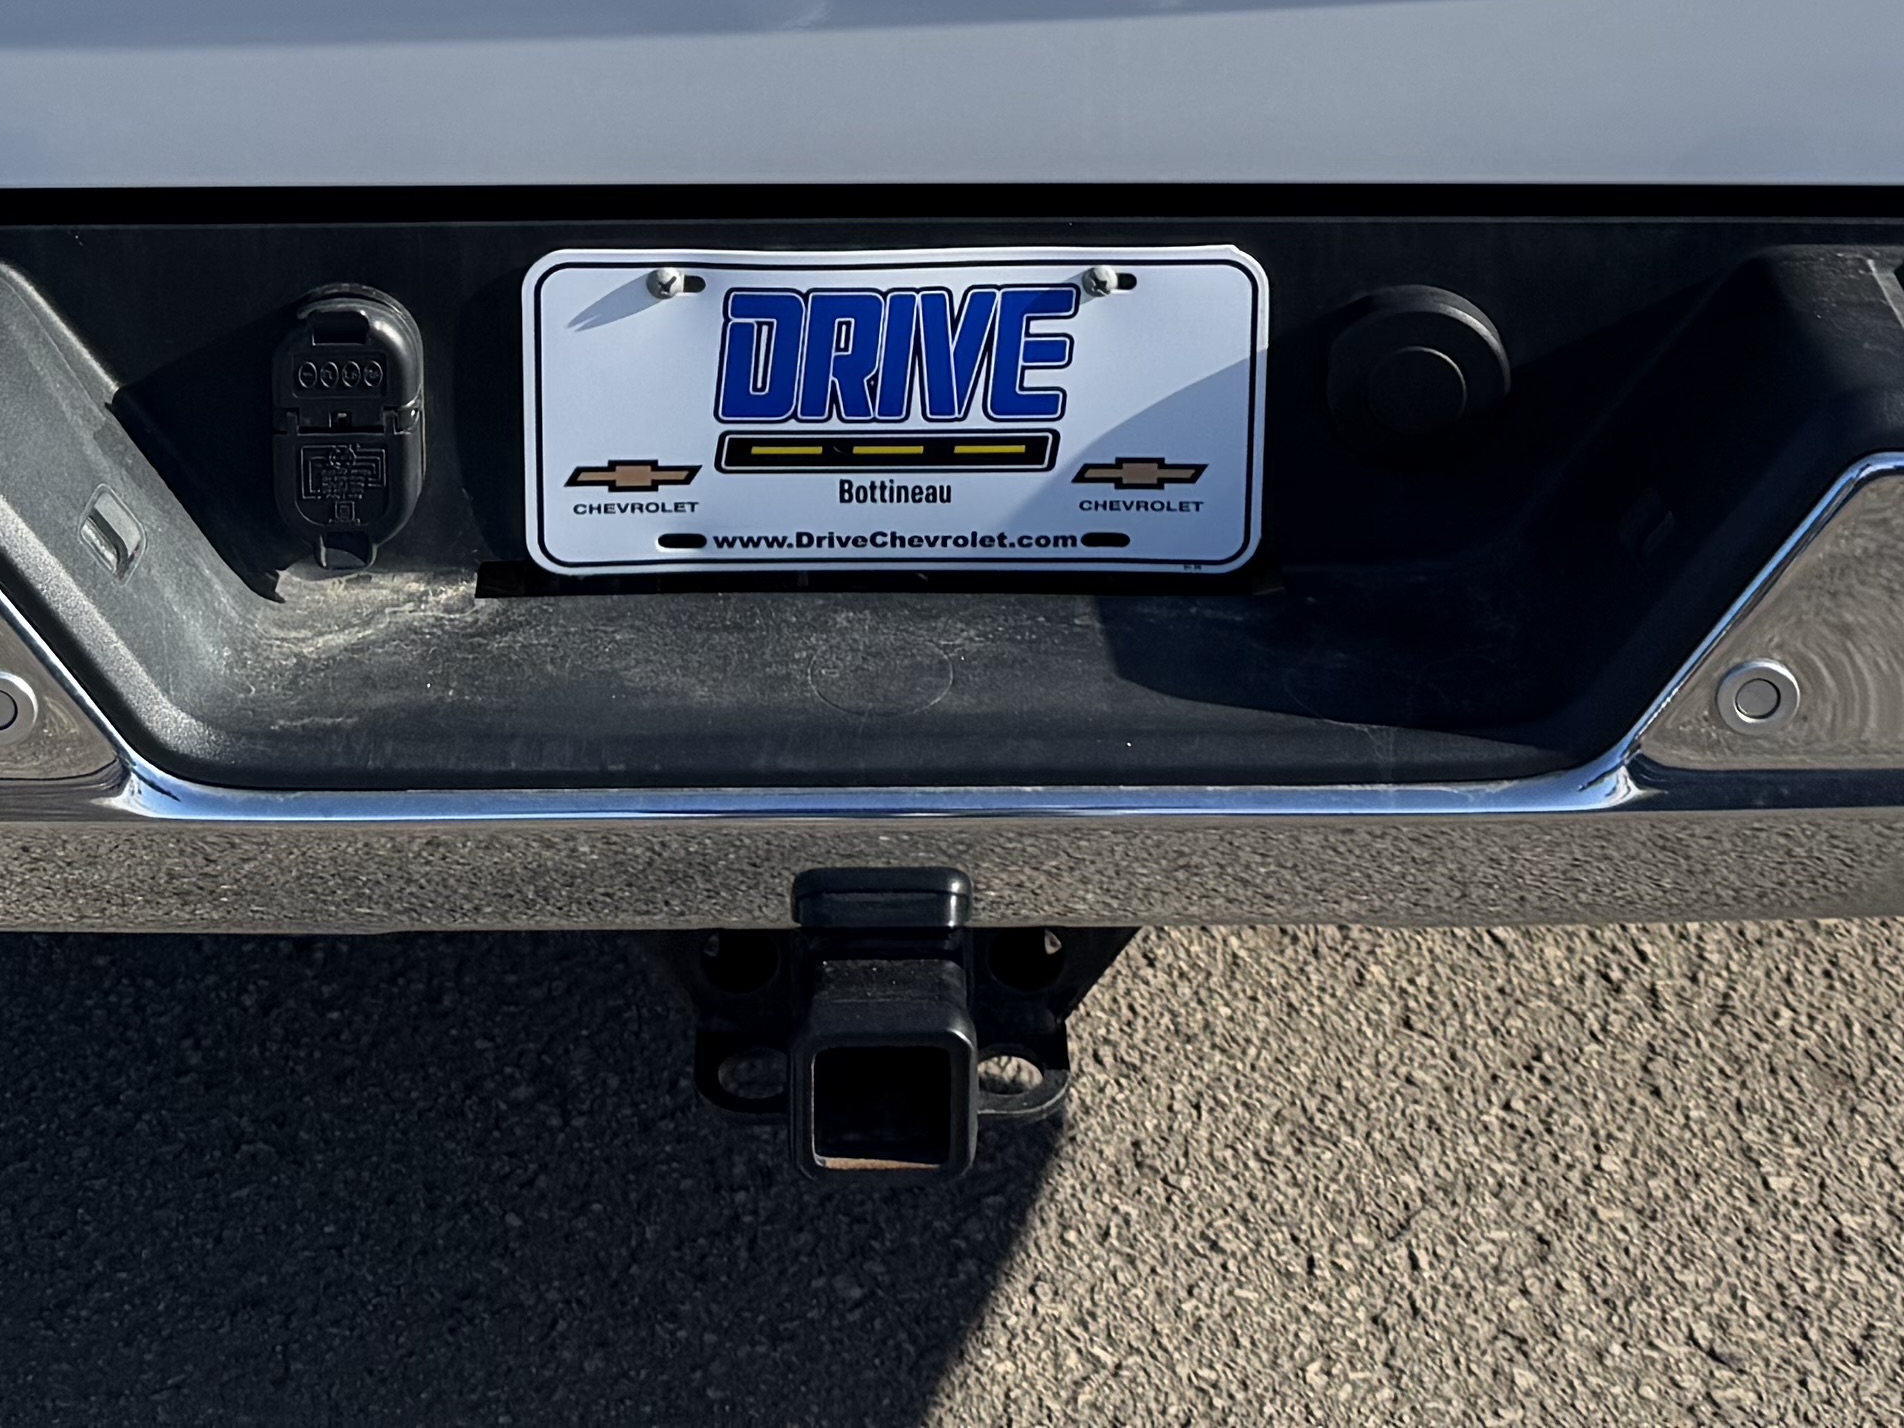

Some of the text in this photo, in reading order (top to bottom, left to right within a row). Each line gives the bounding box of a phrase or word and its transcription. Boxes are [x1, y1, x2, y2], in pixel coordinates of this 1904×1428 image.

[713, 283, 1081, 425] DRIVE
[838, 478, 953, 505] Bottineau
[572, 501, 700, 516] CHEVROLET
[1078, 499, 1205, 513] CHEVROLET
[712, 530, 1079, 549] www.DriveChevrolet.com
